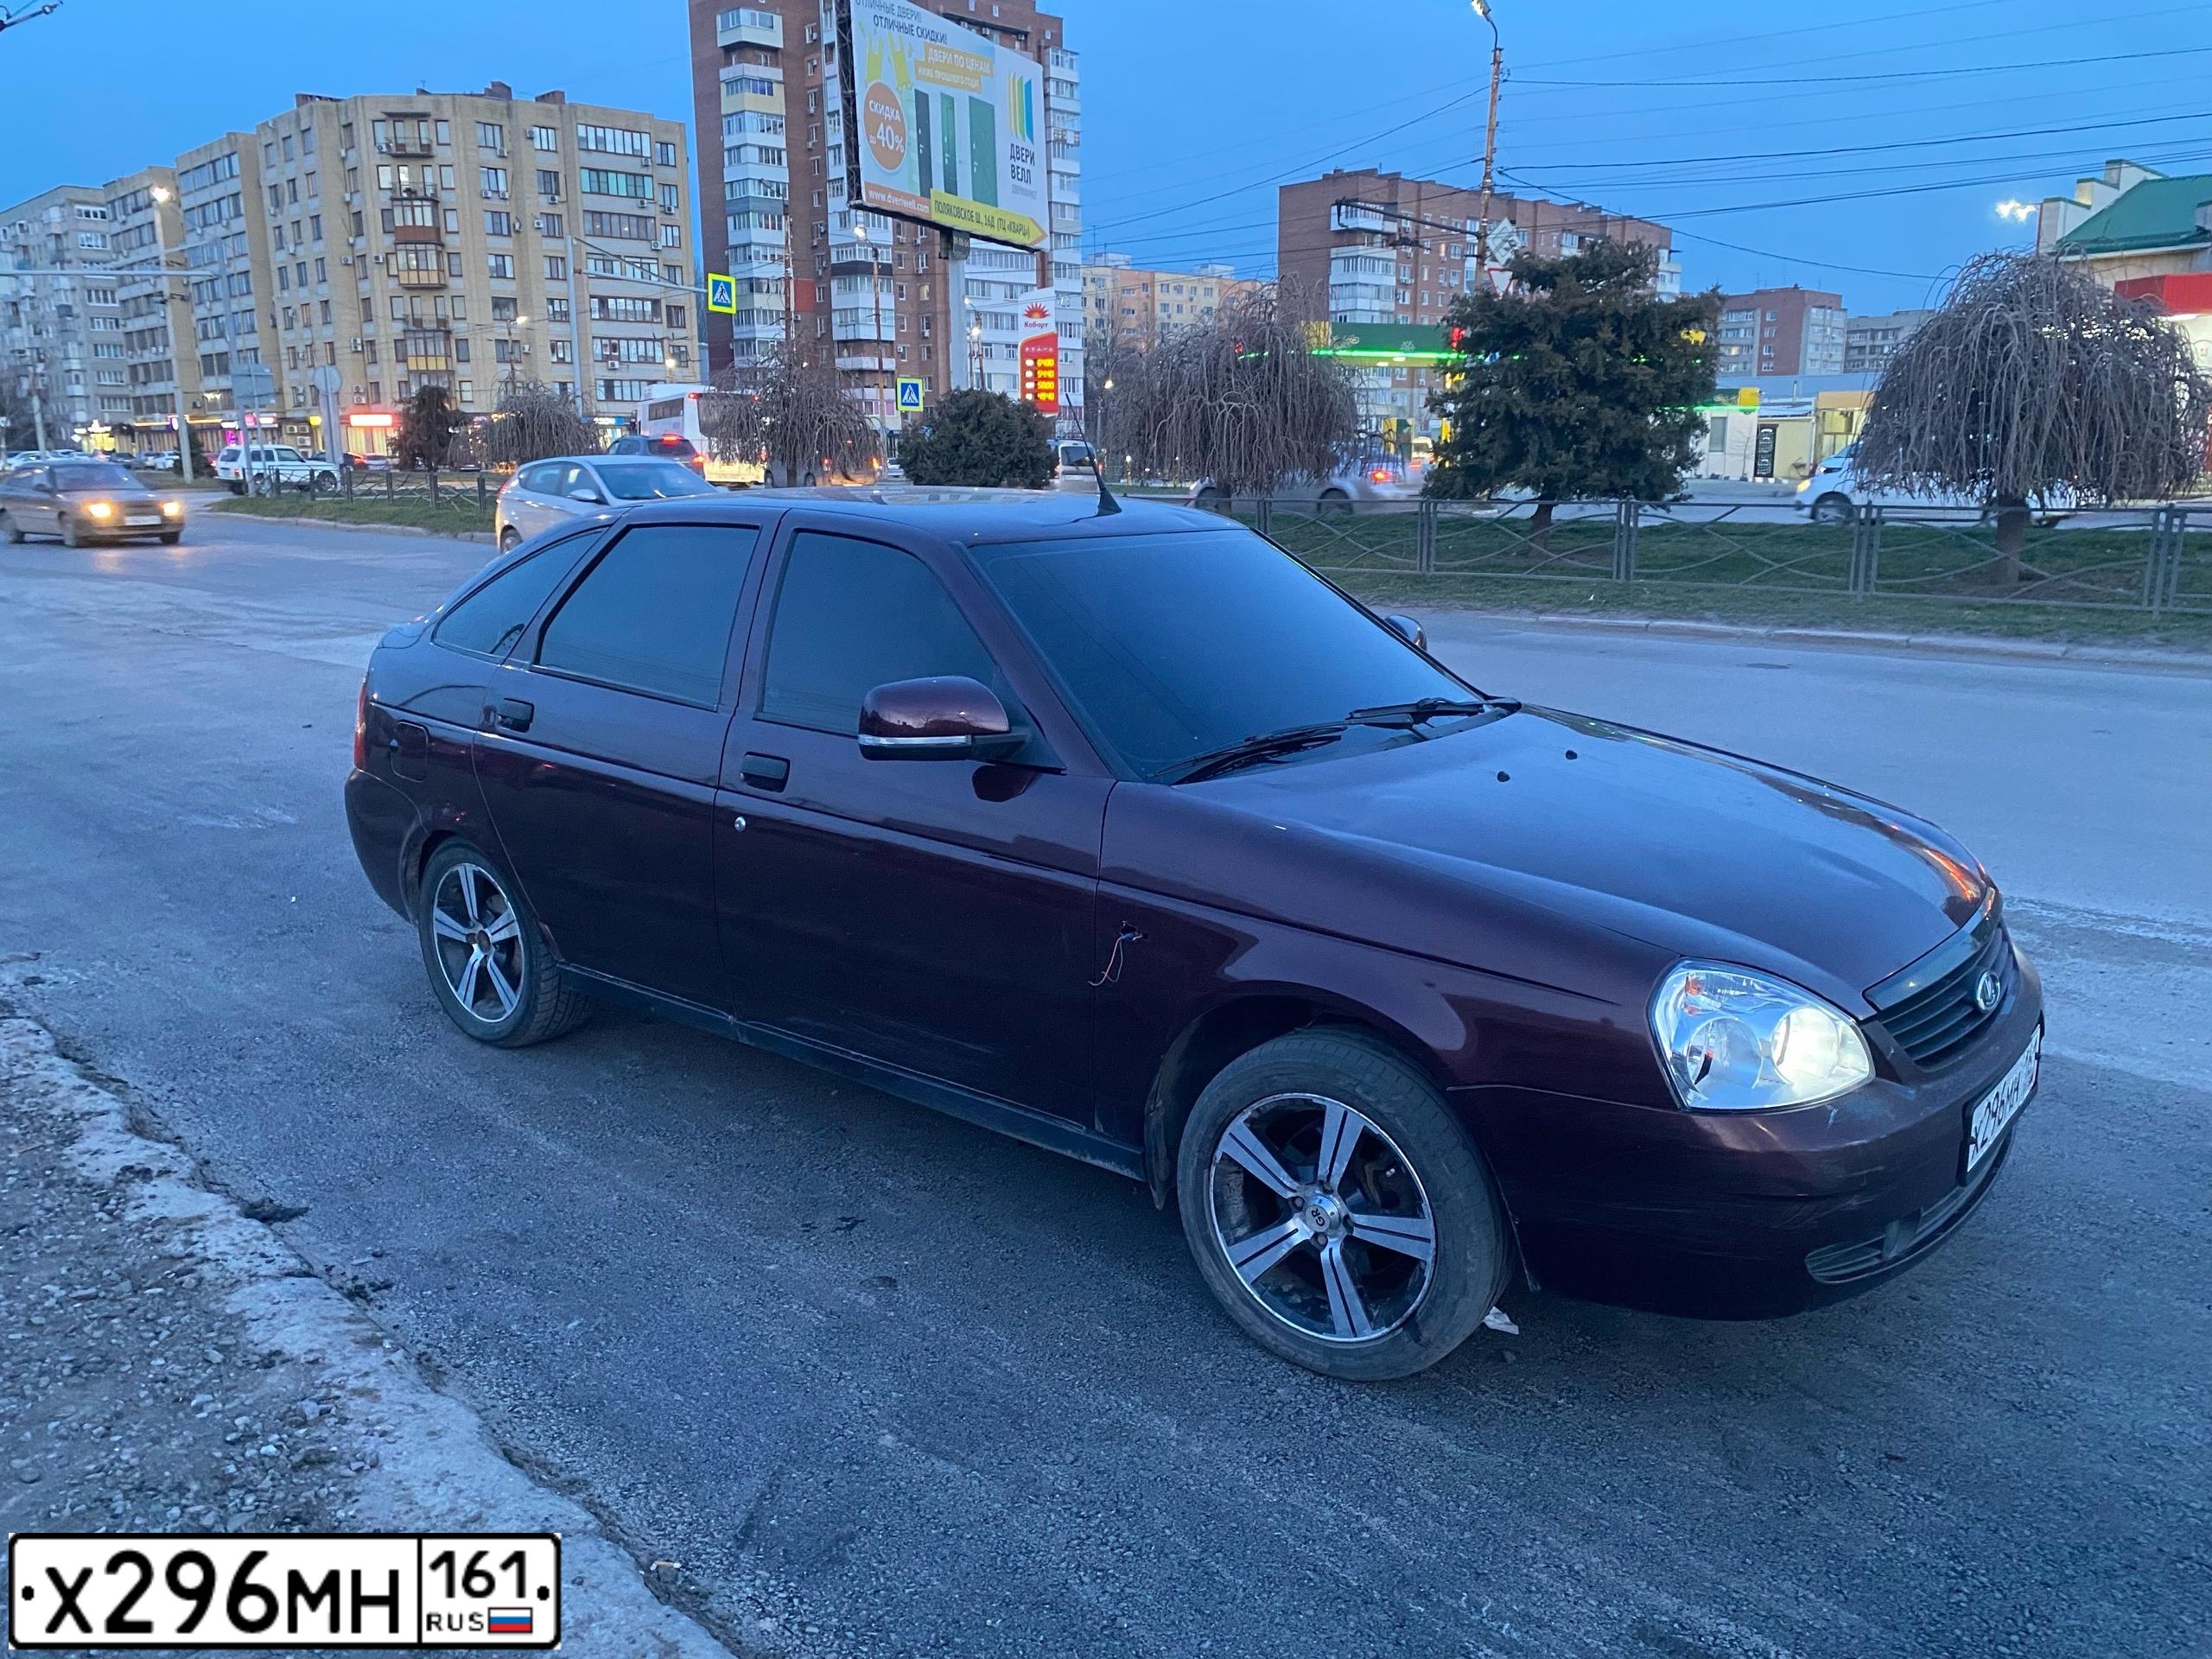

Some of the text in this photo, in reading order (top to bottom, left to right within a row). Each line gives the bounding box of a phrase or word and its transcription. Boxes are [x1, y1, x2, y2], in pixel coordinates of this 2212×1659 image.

[873, 14, 948, 45] ОТЛИЧНЫЕ СКИДКИ!
[927, 48, 953, 65] ДВЕРИ
[954, 54, 965, 68] ПО
[868, 99, 901, 122] СКИДКА
[877, 123, 905, 153] 40%
[1009, 143, 1035, 167] ДВЕРИ
[1010, 163, 1032, 185] ВЕЛЛ
